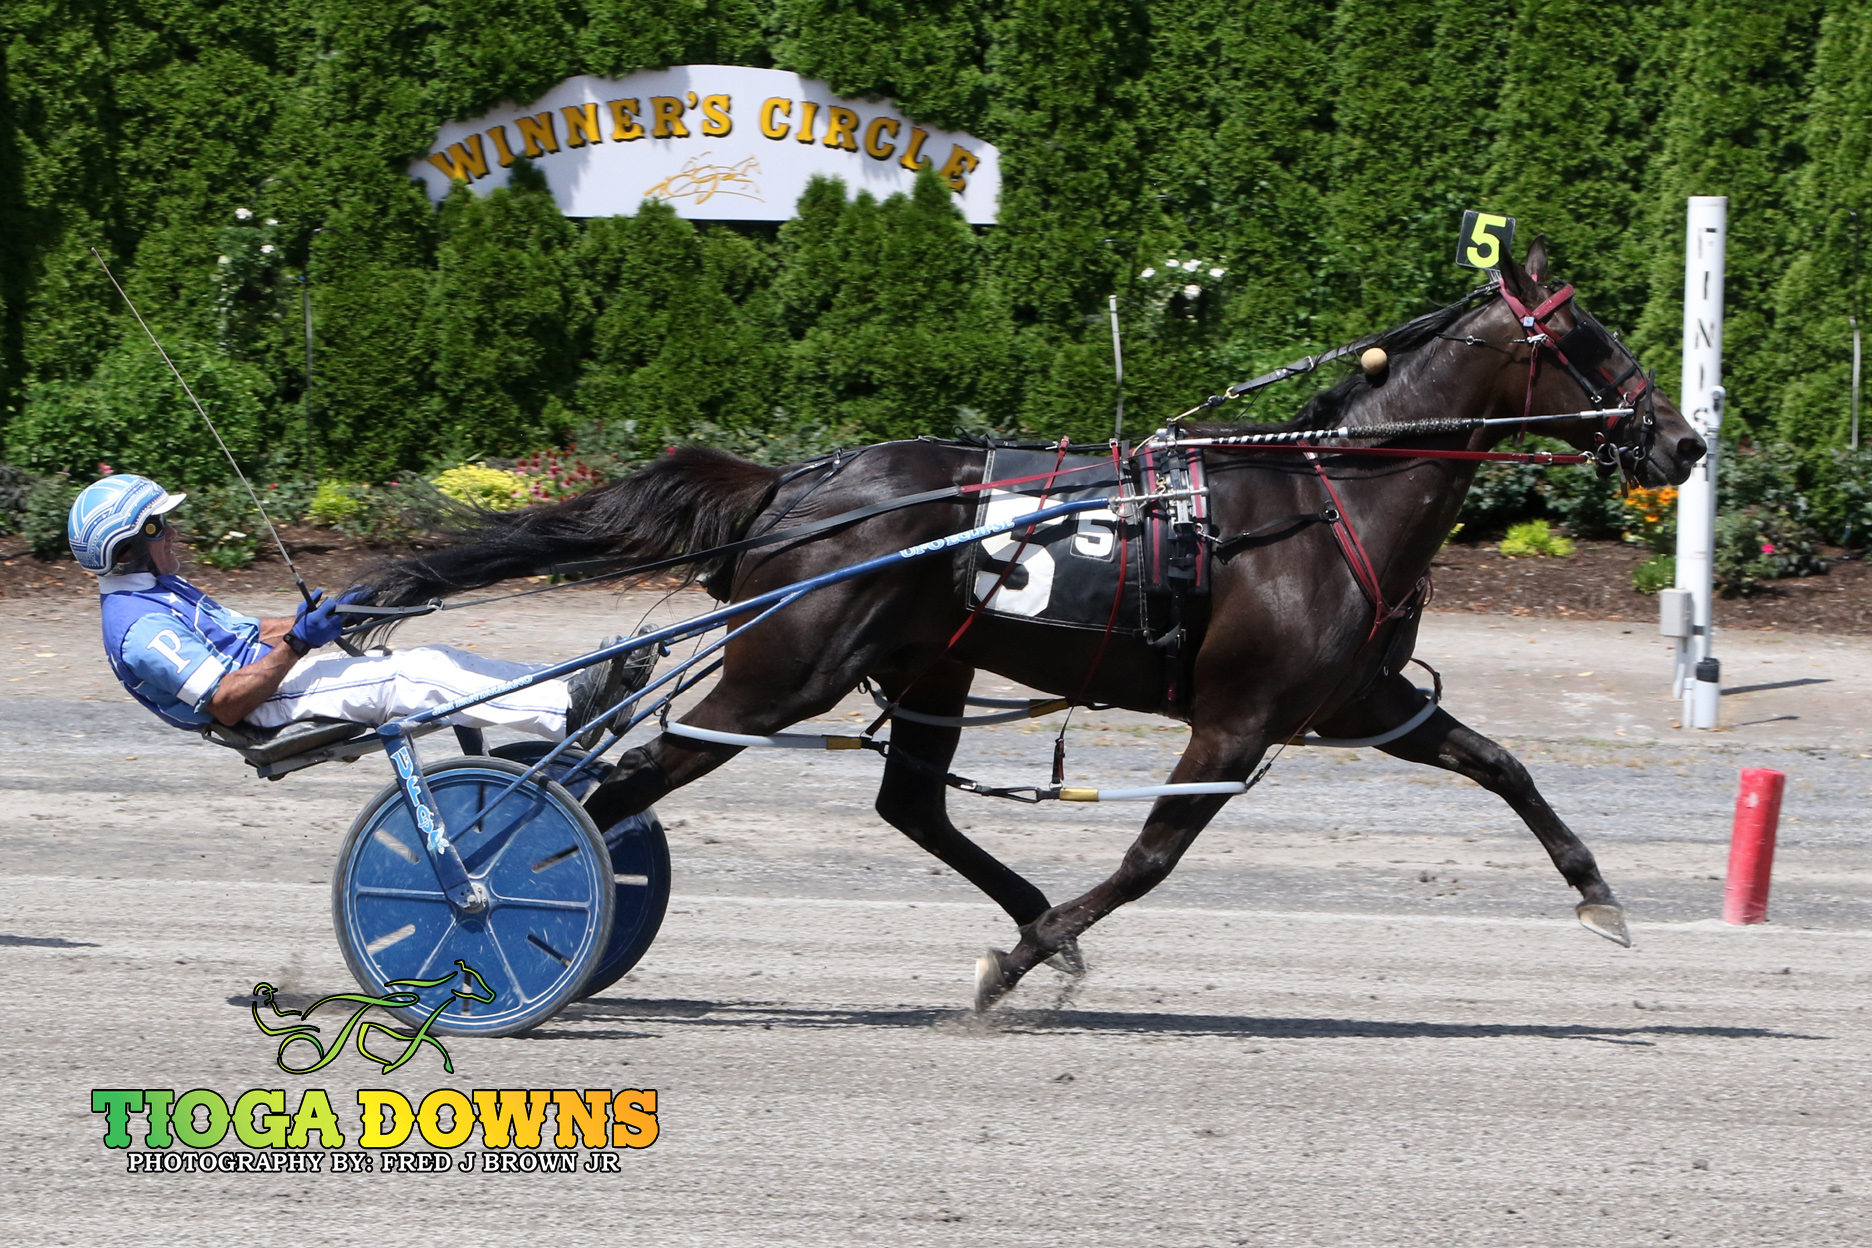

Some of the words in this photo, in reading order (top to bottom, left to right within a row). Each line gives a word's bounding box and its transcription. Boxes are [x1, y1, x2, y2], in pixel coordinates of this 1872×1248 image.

[427, 93, 732, 184] WINNER'S
[760, 97, 979, 194] CIRCLE
[1466, 212, 1507, 269] 5
[974, 488, 1068, 617] 5
[1075, 508, 1114, 557] 5
[146, 629, 192, 675] P
